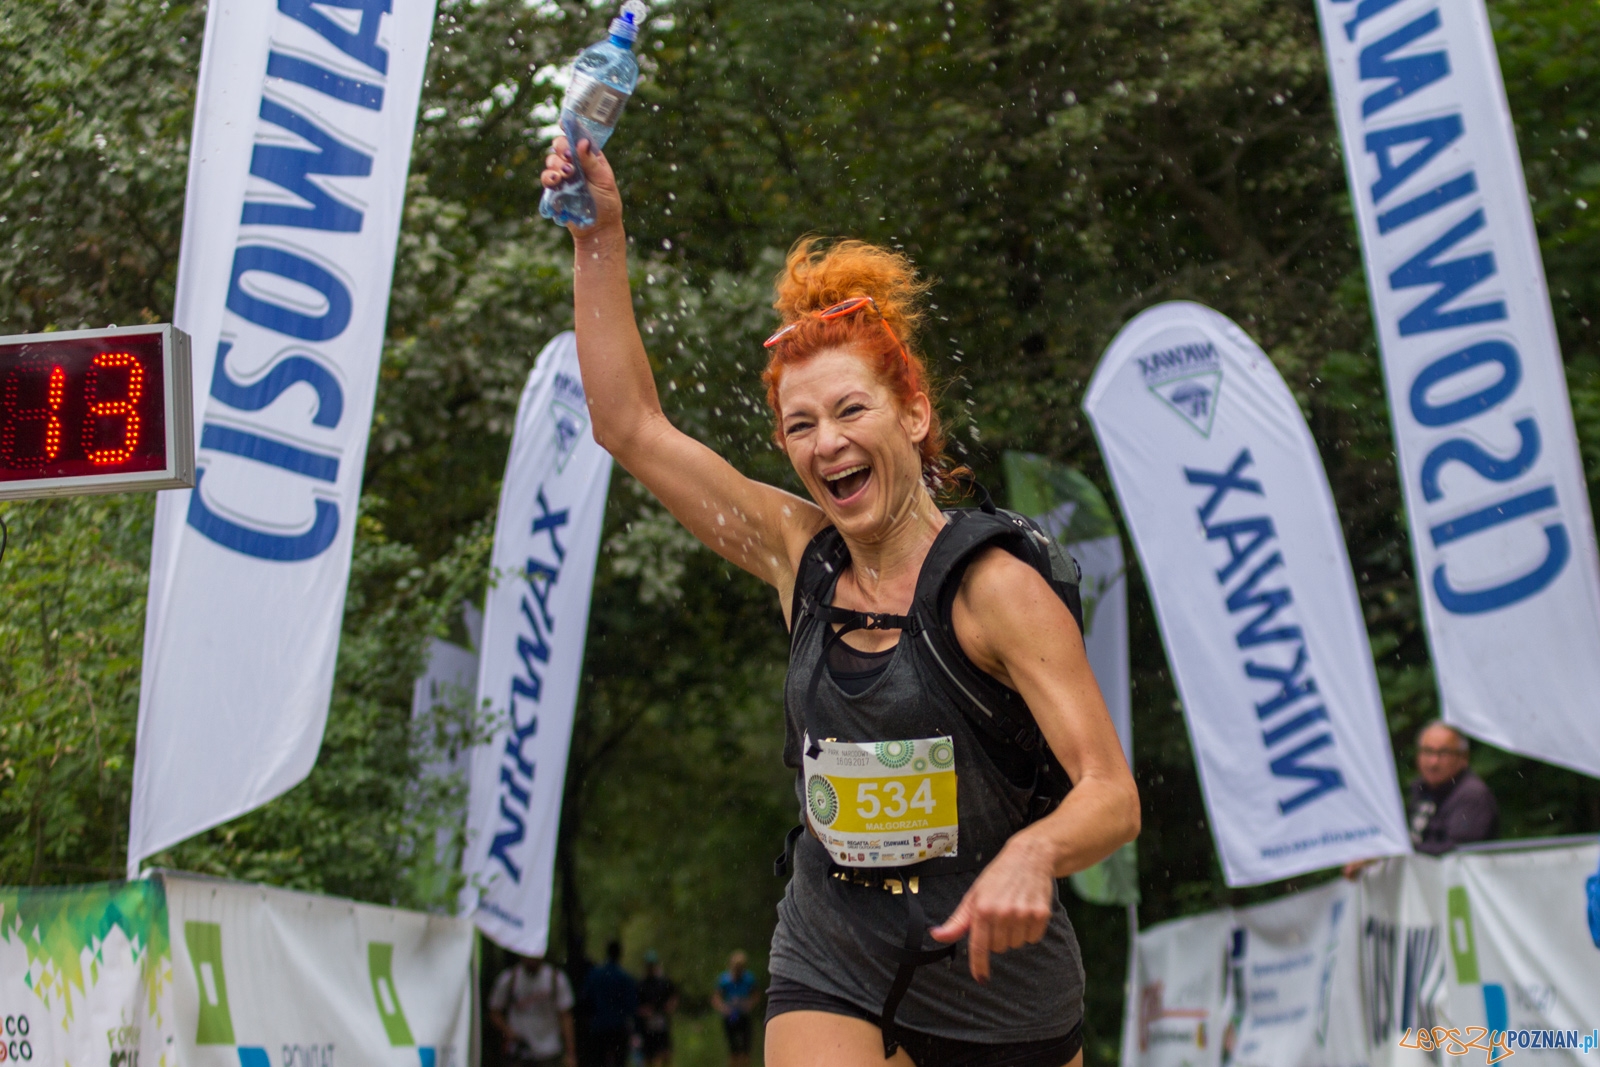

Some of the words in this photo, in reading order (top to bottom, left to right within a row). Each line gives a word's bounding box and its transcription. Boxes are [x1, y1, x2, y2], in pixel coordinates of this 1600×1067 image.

[46, 352, 145, 465] 13
[488, 485, 569, 883] NIKWAX
[856, 778, 936, 819] 534
[865, 819, 929, 831] MAŁGORZATA
[884, 839, 910, 848] CISOWIANKA
